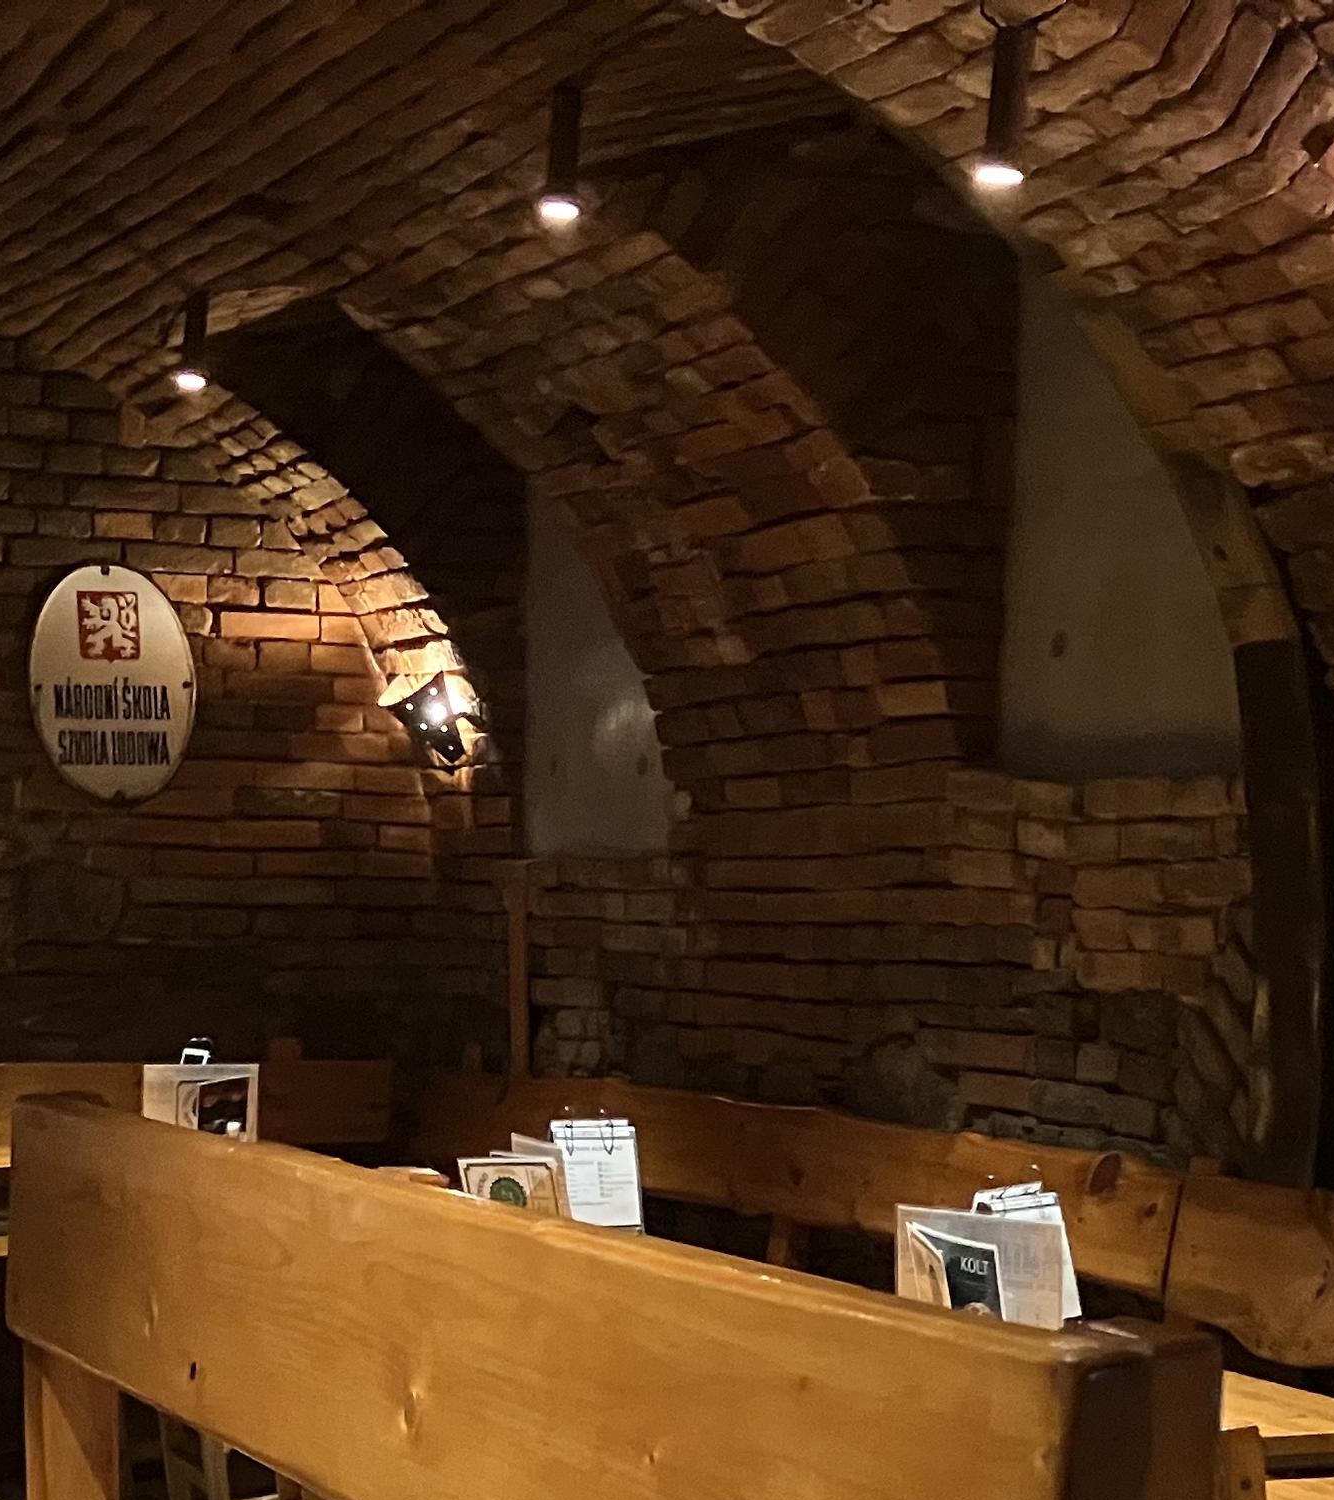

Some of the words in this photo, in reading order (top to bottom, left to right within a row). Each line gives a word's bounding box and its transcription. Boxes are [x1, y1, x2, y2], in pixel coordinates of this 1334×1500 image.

[53, 676, 119, 720] NÁRODNÍ
[122, 676, 172, 720] ŠKOLA
[111, 730, 171, 766] LUDOWA
[960, 1256, 989, 1275] KOLT
